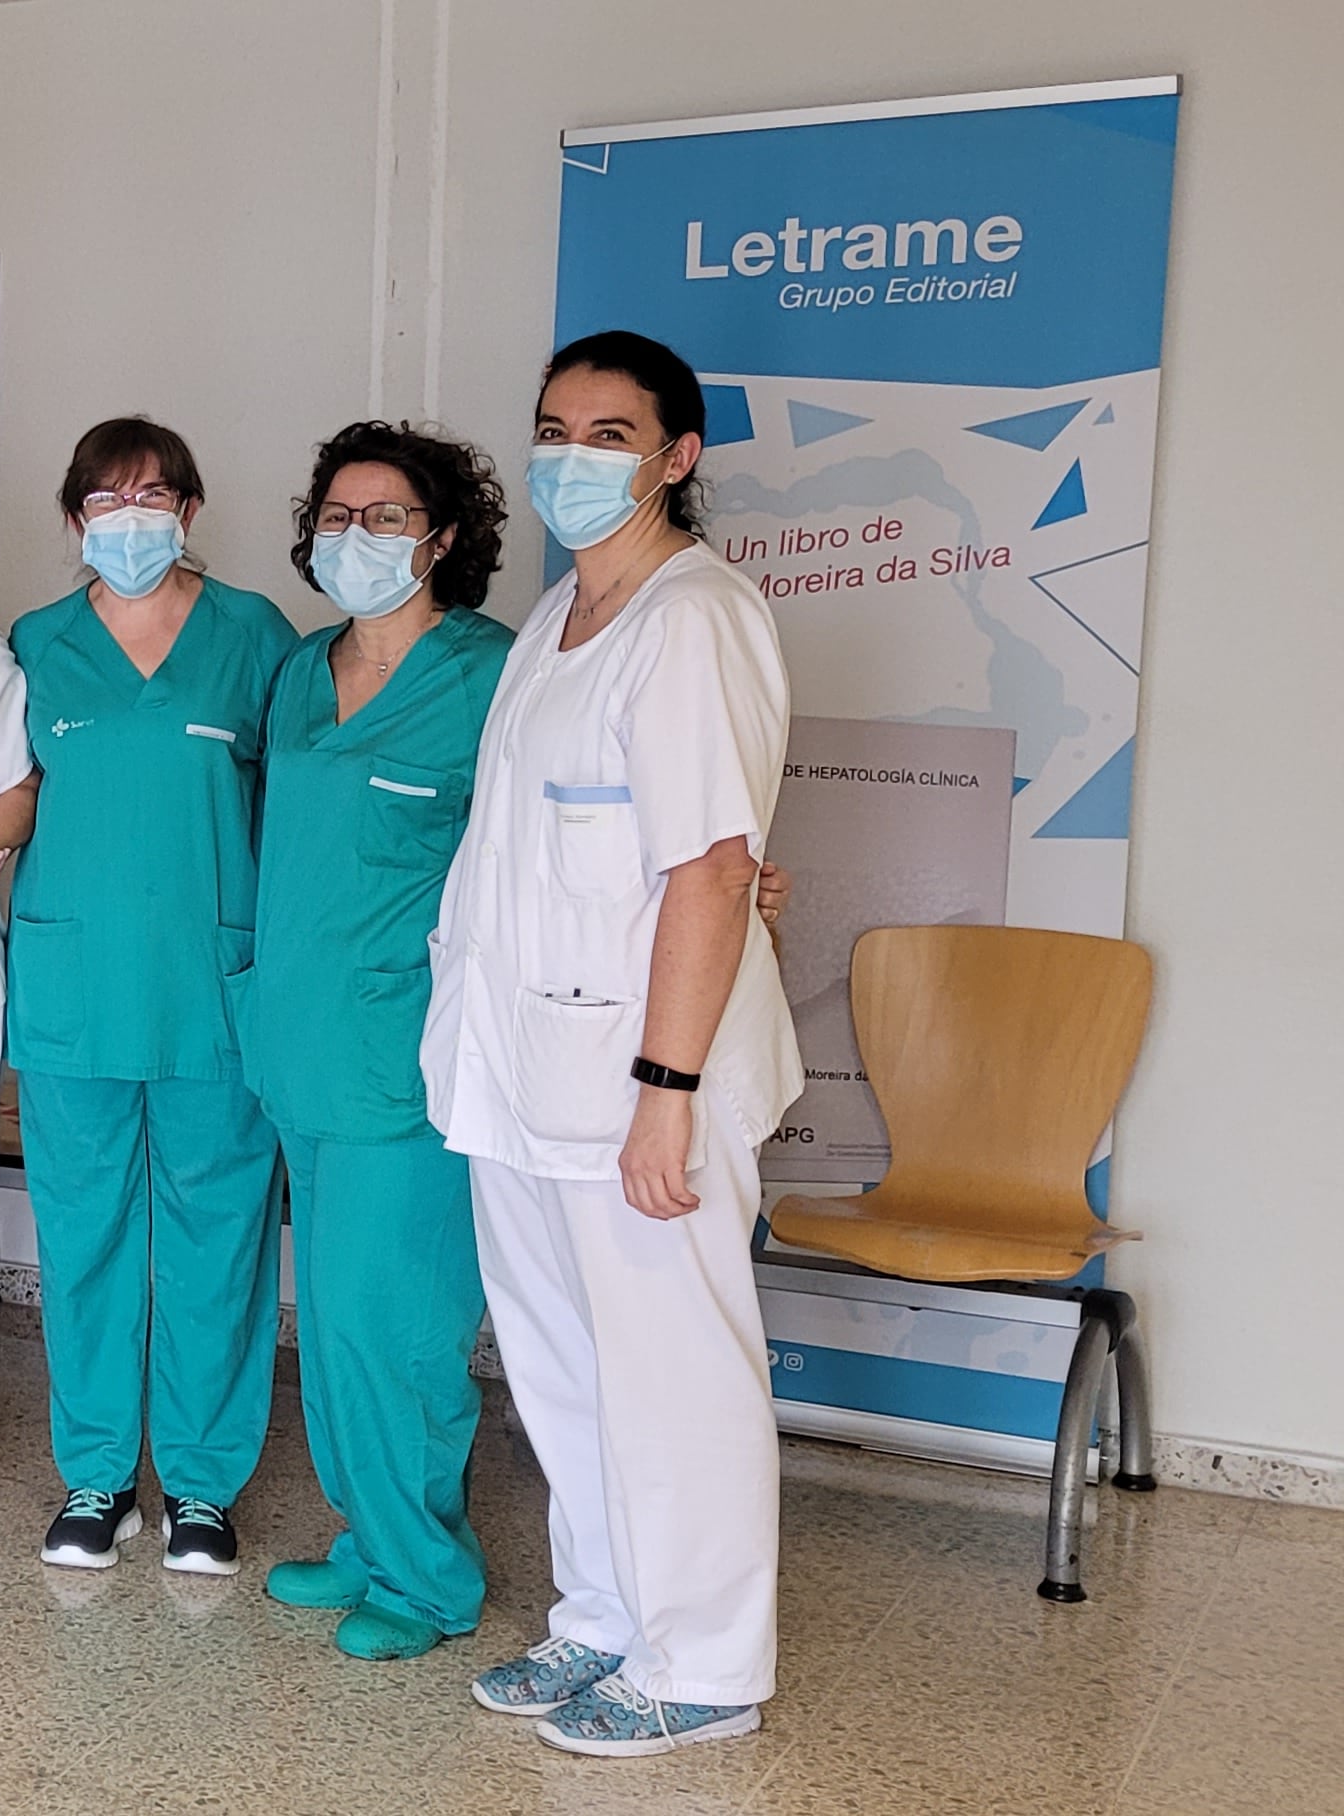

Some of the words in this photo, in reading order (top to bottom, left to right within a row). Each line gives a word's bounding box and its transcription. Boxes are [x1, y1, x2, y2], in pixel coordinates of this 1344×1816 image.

[685, 214, 1024, 280] Letrame
[778, 282, 876, 312] Grupo
[884, 271, 1019, 304] Editorial
[725, 536, 768, 564] Un
[778, 527, 850, 556] libro
[861, 515, 903, 543] de
[876, 555, 917, 584] da
[929, 544, 1012, 576] Silva
[783, 764, 804, 778] DE
[809, 765, 916, 785] HEPATOLOGÍA
[919, 769, 980, 788] CLÍNICA
[804, 1068, 851, 1081] Moreira
